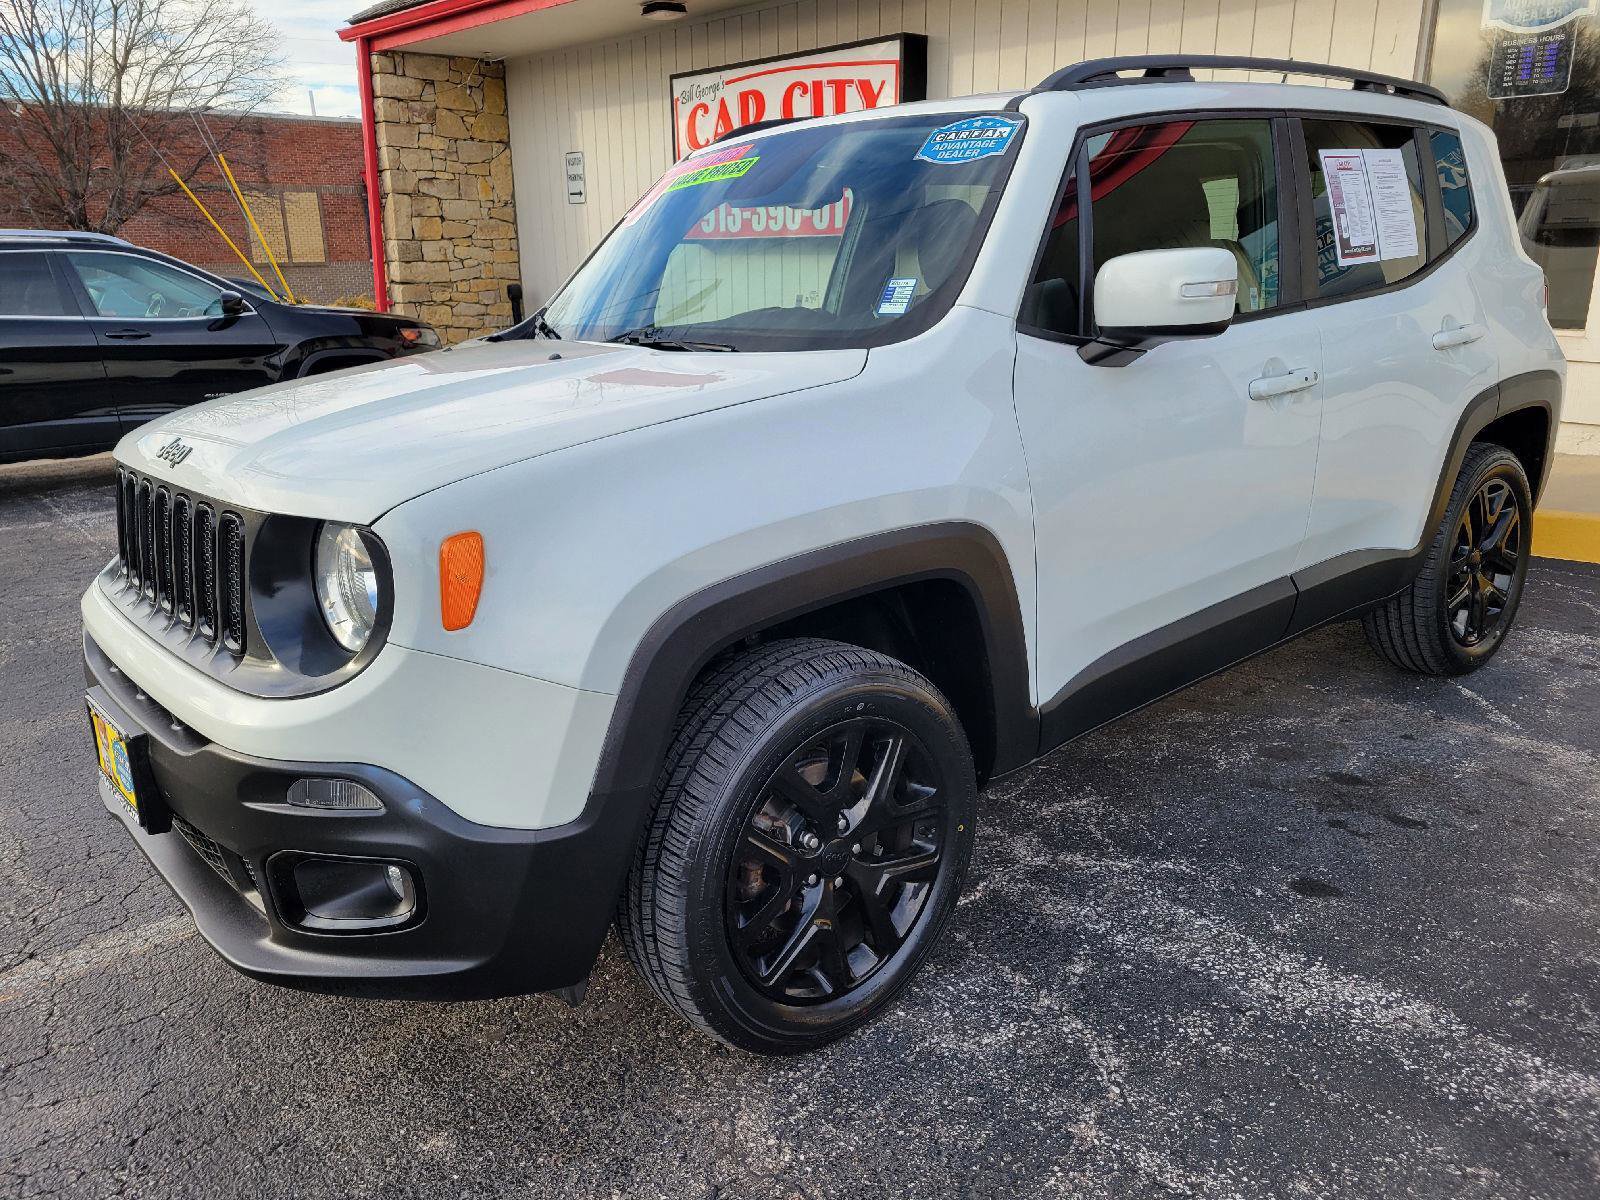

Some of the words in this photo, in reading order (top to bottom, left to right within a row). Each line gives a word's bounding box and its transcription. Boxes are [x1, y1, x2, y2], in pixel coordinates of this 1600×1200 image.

[1503, 37, 1538, 47] BUSINESS
[1540, 34, 1566, 43] HOURS
[680, 83, 695, 105] Bill
[695, 75, 725, 102] George's
[687, 88, 767, 151] CAR
[781, 79, 886, 119] CITY
[936, 127, 1011, 142] CARFAX
[931, 139, 998, 151] ADVANTAGE
[937, 149, 980, 159] DEALER
[156, 437, 193, 469] Jeep
